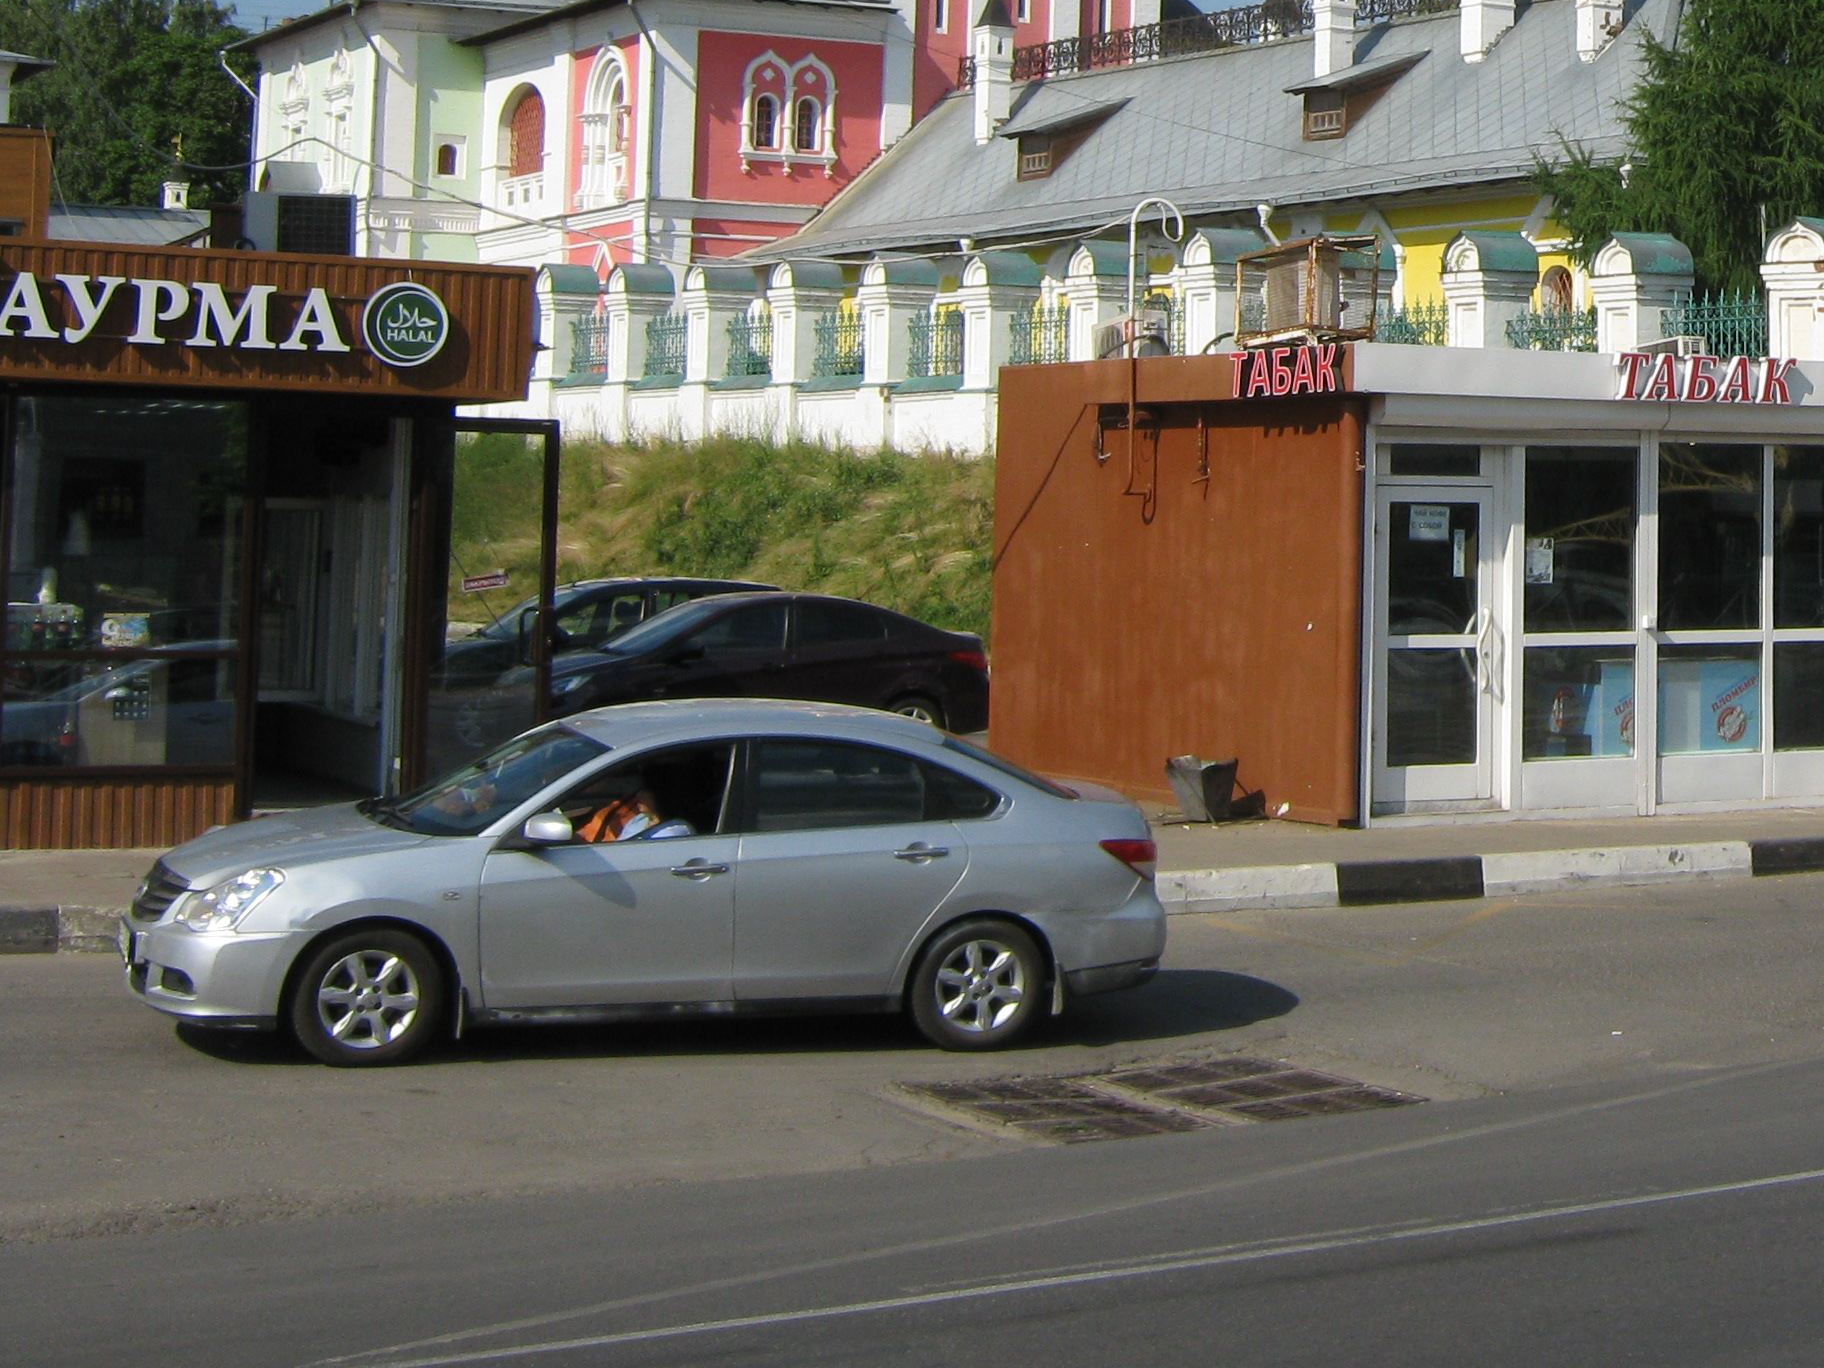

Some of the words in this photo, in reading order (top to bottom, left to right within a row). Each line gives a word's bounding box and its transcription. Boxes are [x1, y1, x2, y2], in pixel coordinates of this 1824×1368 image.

[0, 272, 350, 352] АУРМА
[387, 303, 438, 328] حلال
[387, 328, 436, 343] HALAL
[1229, 343, 1336, 398] ТАБАК
[1614, 352, 1797, 404] ТАБАК
